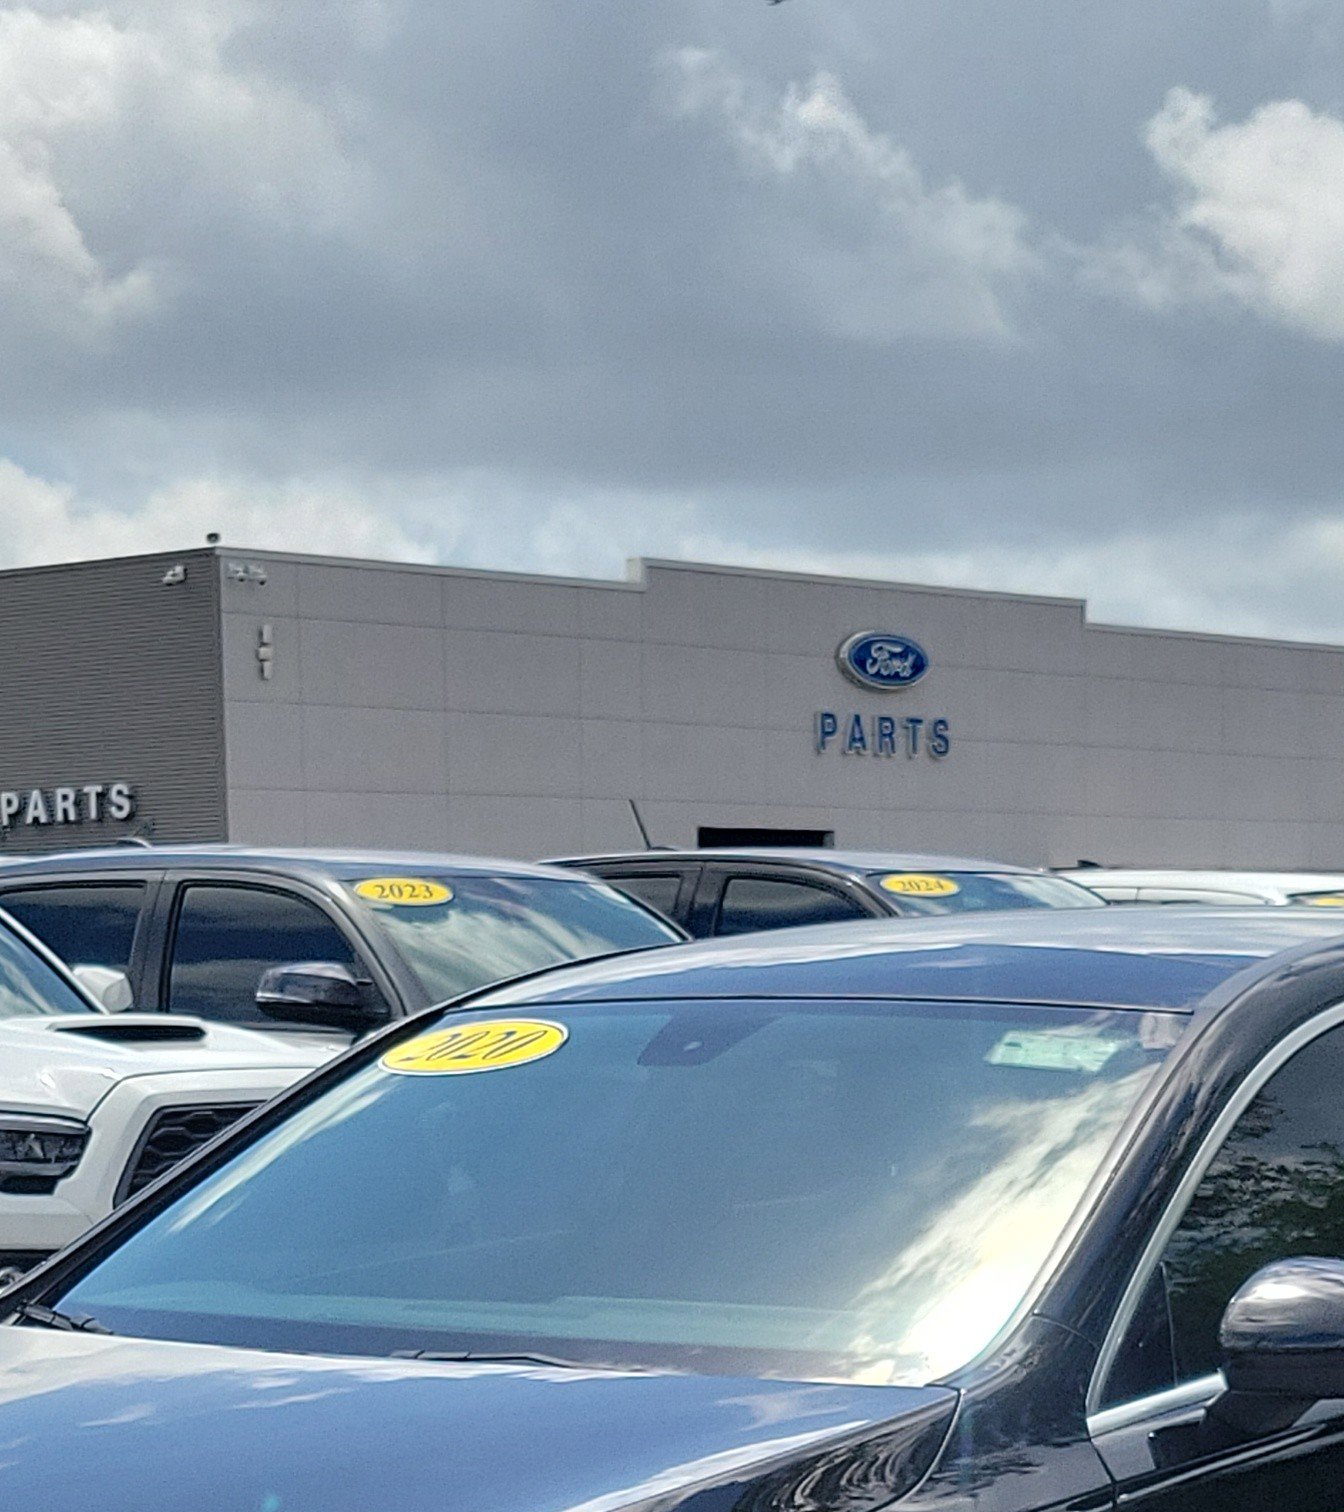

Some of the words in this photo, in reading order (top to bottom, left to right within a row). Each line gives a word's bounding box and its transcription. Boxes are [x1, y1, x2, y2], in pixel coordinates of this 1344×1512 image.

[866, 641, 917, 677] Ford
[819, 712, 950, 757] PARTS
[0, 783, 132, 826] PARTS
[373, 883, 433, 899] 2023
[397, 1030, 548, 1063] 2020
